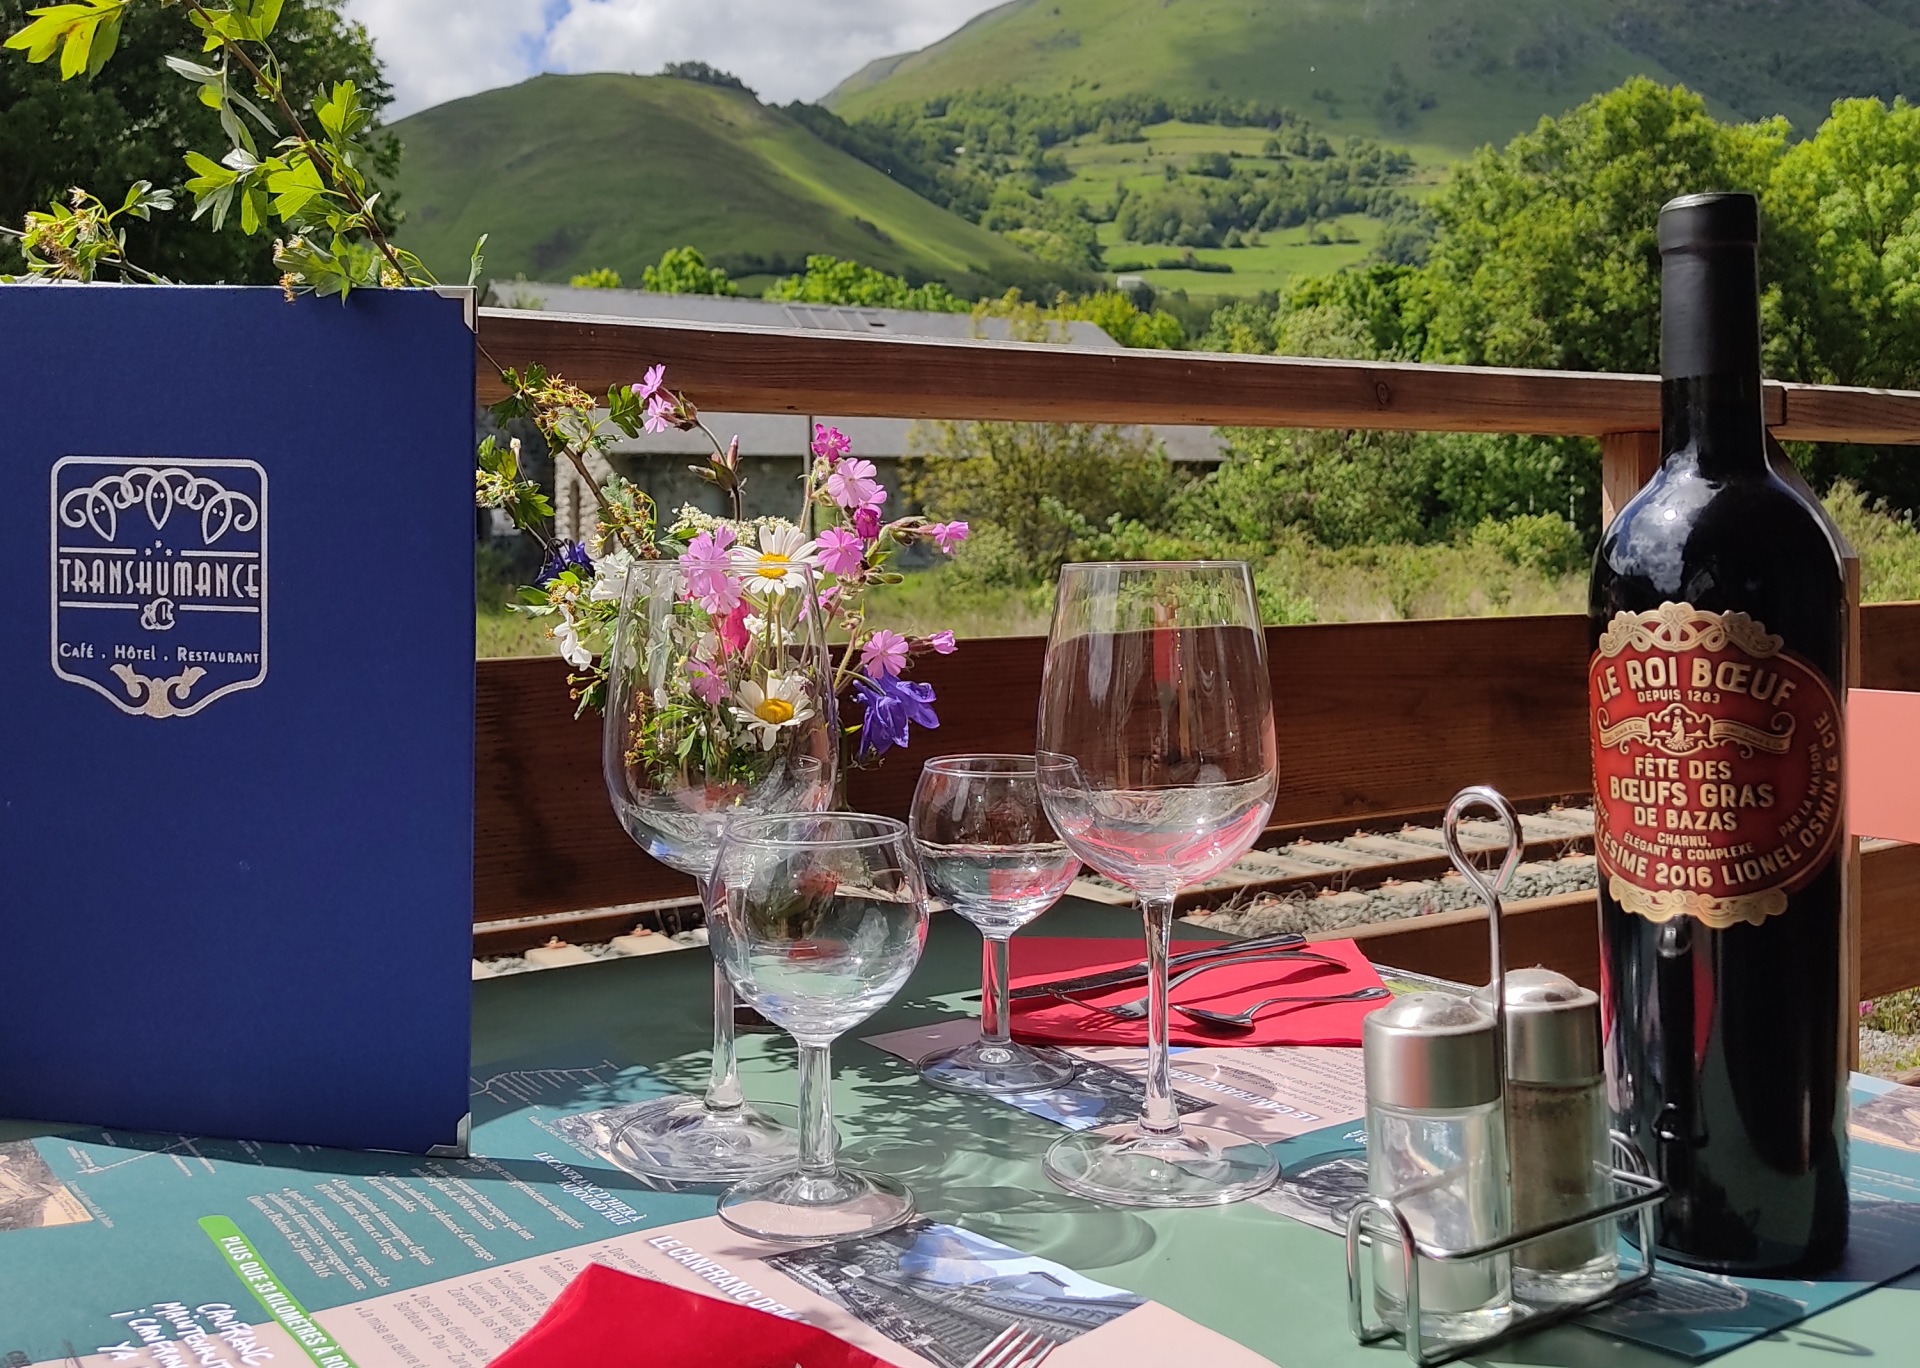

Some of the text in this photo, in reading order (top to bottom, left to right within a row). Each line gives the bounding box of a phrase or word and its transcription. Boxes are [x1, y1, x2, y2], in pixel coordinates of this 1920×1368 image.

[60, 559, 259, 598] TRANSHUMANCE
[1597, 656, 1796, 706] LE ROI BŒUF
[1637, 689, 1720, 703] DEPUIS 1283
[1814, 711, 1836, 748] CIE
[1634, 753, 1732, 780] FÊTE DES
[1610, 776, 1775, 808] BŒUFS GRAS
[1634, 806, 1738, 831] DE BAZAS
[1779, 814, 1801, 838] PAR
[1799, 800, 1813, 817] LA
[1800, 780, 1837, 848] OSMIN
[1623, 831, 1754, 861] ÉLÉGANT & COMPLEXE
[1657, 832, 1711, 847] CHARNU,
[1655, 862, 1714, 888] 2016
[1721, 844, 1801, 886] LIONEL
[547, 1160, 603, 1194] CANFRANC
[556, 1180, 633, 1226] AUJOURD'HUI
[269, 1213, 292, 1233] Bedous
[308, 1207, 343, 1231] décennies
[340, 1201, 375, 1231] Haut-Béarn
[376, 1239, 406, 1260] Aragon
[468, 1209, 496, 1229] ouvriers
[503, 1222, 526, 1230] qui
[518, 1230, 534, 1240] ont
[220, 1236, 253, 1261] PLUS
[286, 1232, 300, 1240] le
[291, 1239, 310, 1248] 26
[332, 1231, 347, 1239] de
[339, 1238, 362, 1255] lutte,
[375, 1212, 413, 1245] interrompue
[405, 1246, 435, 1264] depuis
[459, 1234, 495, 1260] d'ouvrages
[293, 1247, 316, 1261] juin
[321, 1245, 351, 1274] voyageurs
[346, 1274, 366, 1290] entre
[354, 1257, 381, 1277] reprise
[559, 1258, 575, 1272] Les
[607, 1248, 623, 1260] Des
[239, 1261, 269, 1282] QUE
[309, 1261, 334, 1277] 2016
[648, 1235, 678, 1250] LE
[667, 1246, 762, 1301] CANFRANC
[254, 1281, 277, 1293] 33
[374, 1277, 390, 1287] des
[488, 1277, 534, 1313] touristiques
[507, 1271, 549, 1302] Une porte
[447, 1288, 484, 1318] Zaragoza,
[481, 1315, 498, 1330] los
[468, 1282, 526, 1328] Lourdes, Vallée
[263, 1292, 328, 1346] KILOMÈTRES
[358, 1310, 373, 1319] La
[368, 1317, 390, 1335] mise
[382, 1333, 397, 1345] en
[393, 1301, 426, 1332] Bordeaux
[428, 1335, 447, 1350] Pau
[414, 1296, 488, 1359] Des trains directs de
[196, 1303, 274, 1366] CANFRANC
[312, 1344, 340, 1356] À
